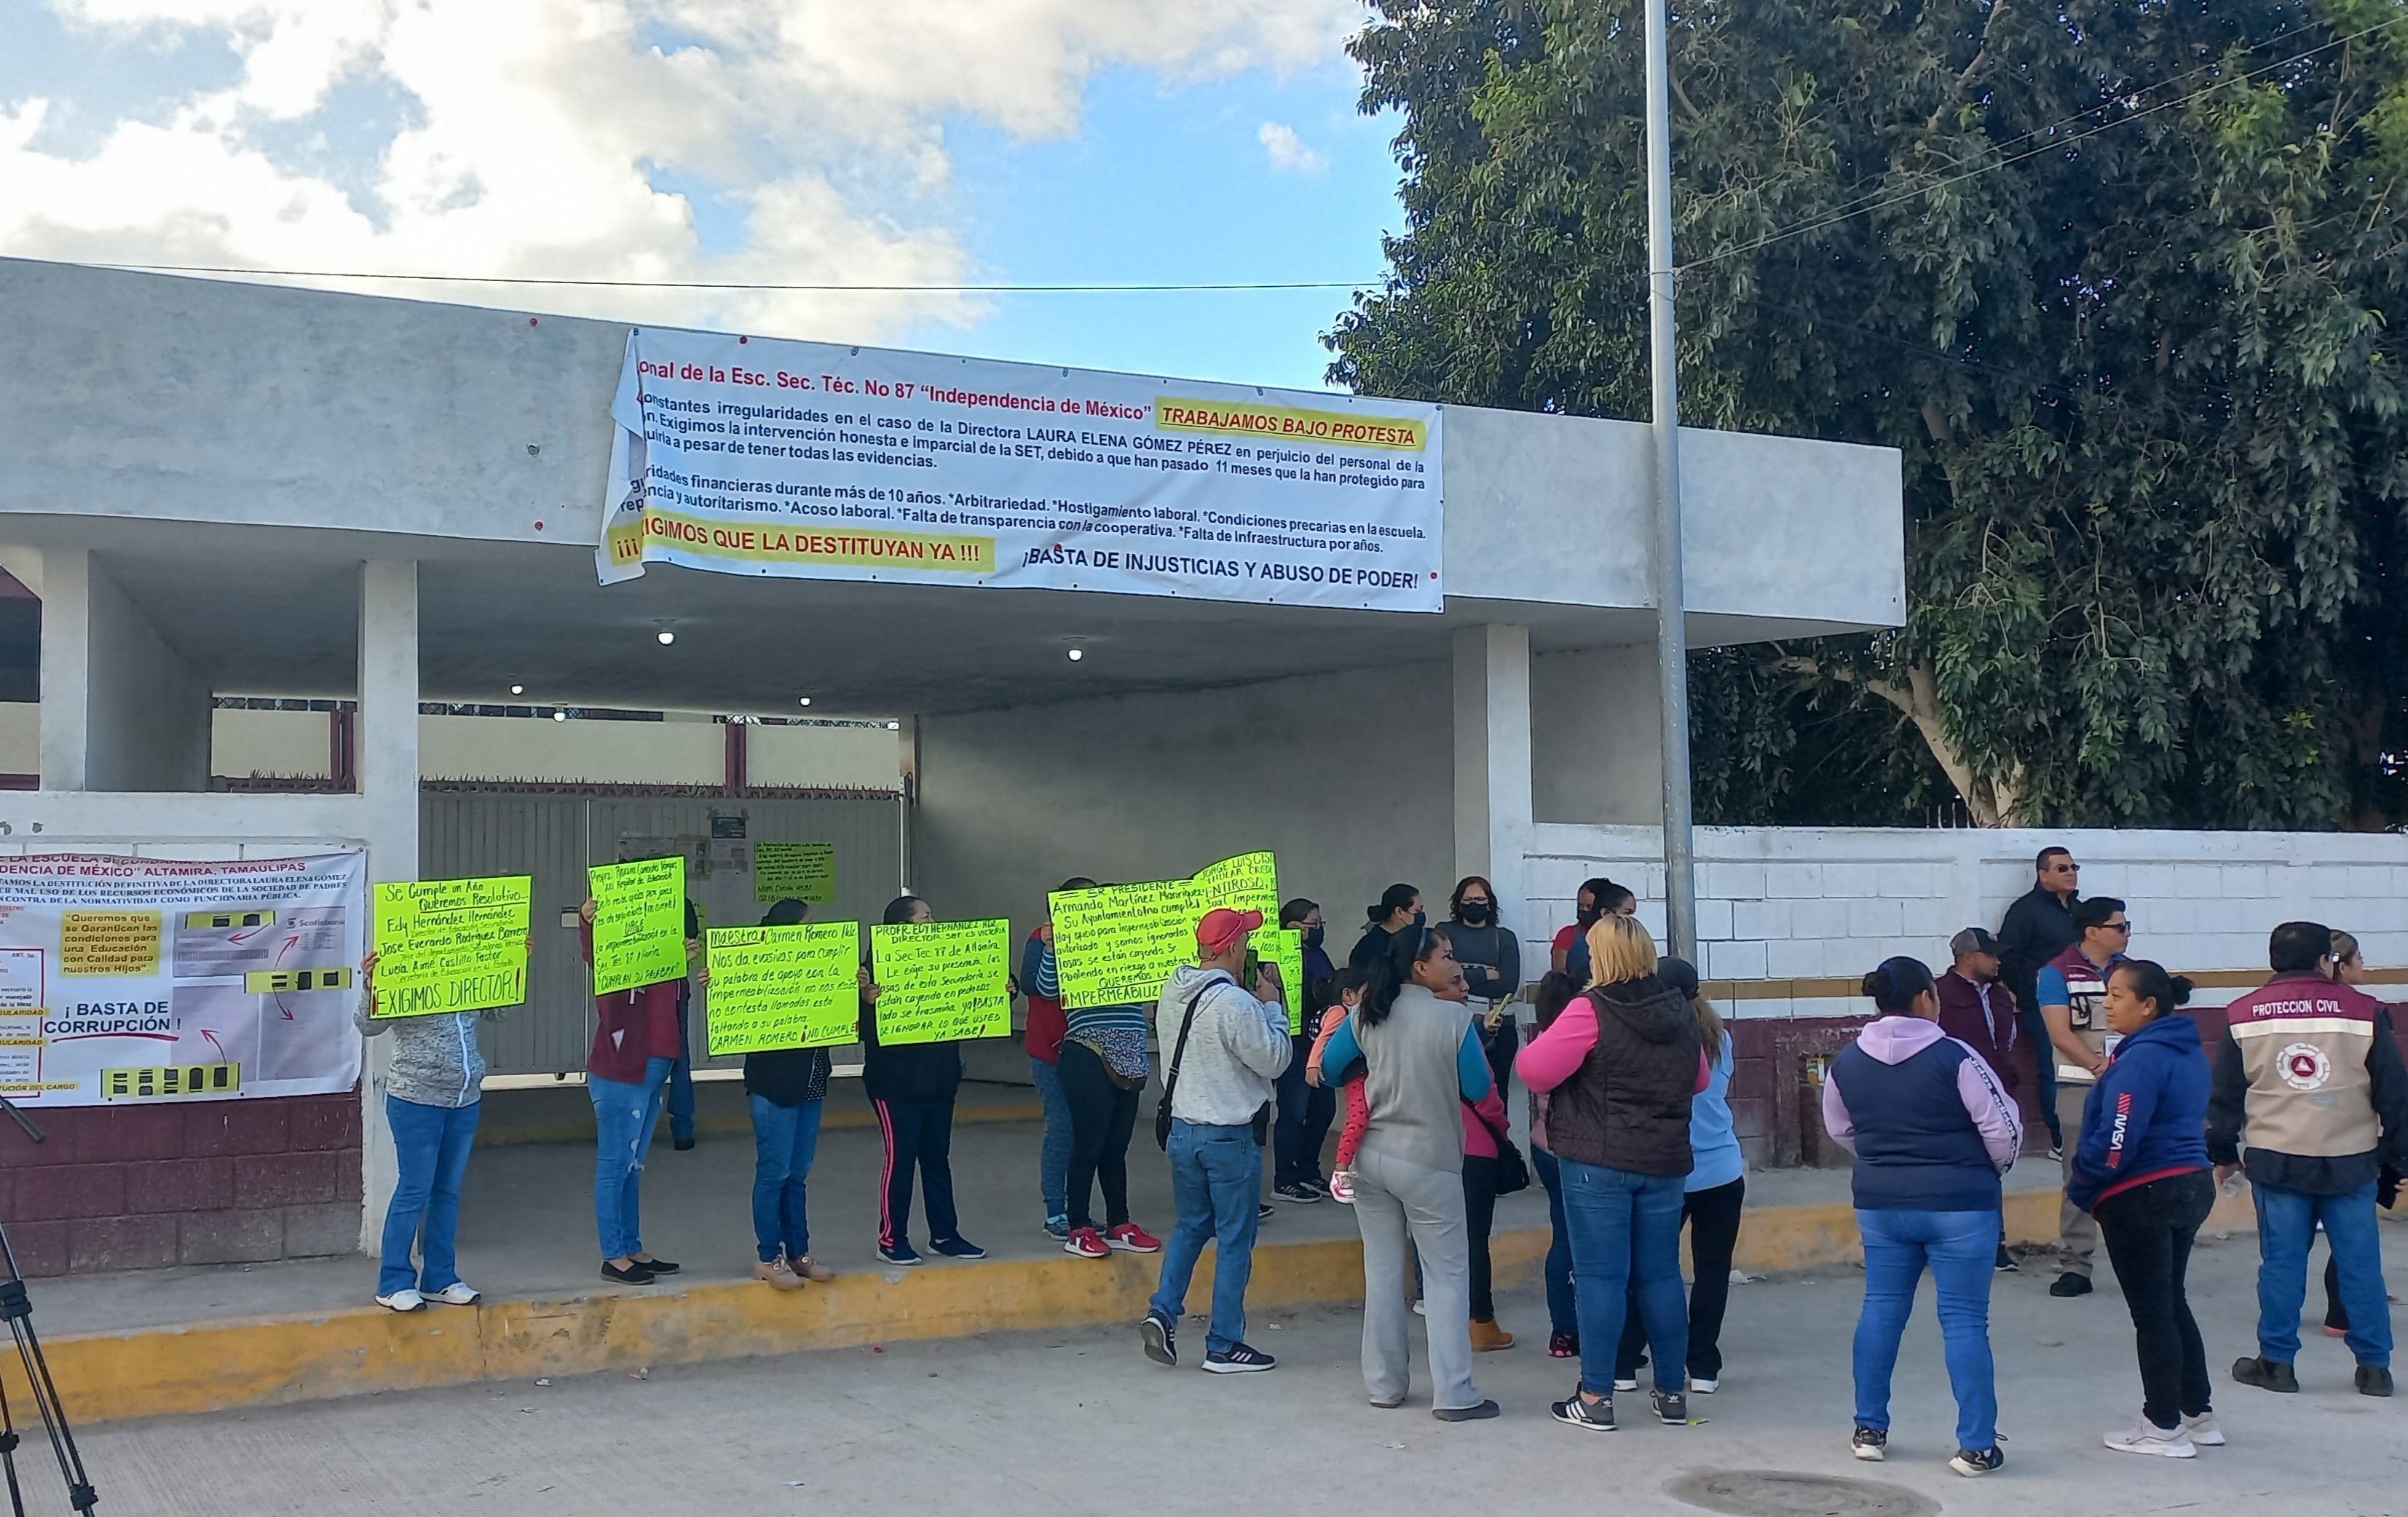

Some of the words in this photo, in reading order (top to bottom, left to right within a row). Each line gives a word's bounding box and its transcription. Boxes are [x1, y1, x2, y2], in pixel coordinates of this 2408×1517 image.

[639, 361, 674, 378] onal
[681, 364, 703, 381] de
[709, 366, 725, 382] la
[732, 367, 770, 386] Esc.
[777, 371, 815, 390] Sec.
[822, 375, 859, 393] Téc.
[865, 380, 889, 397] No
[895, 383, 915, 398] 87
[1061, 398, 1081, 413] de
[718, 401, 828, 423] irregularidades
[835, 413, 853, 424] en
[859, 413, 871, 426] el
[877, 417, 912, 429] caso
[917, 419, 934, 431] de
[941, 421, 952, 433] la
[958, 422, 1020, 439] Directora
[1027, 428, 1076, 443] LAURA
[1082, 432, 1127, 448] ELENA
[1132, 435, 1183, 452] GÓMEZ
[1188, 439, 1231, 455] PÉREZ
[1236, 447, 1250, 458] en
[1257, 450, 1310, 463] perjuicio
[1316, 453, 1334, 465] del
[1340, 456, 1390, 470] personal
[1396, 459, 1411, 470] de
[1416, 462, 1424, 472] la
[1164, 407, 1277, 431] TRABAJAMOS
[1283, 418, 1327, 436] BAJO
[1332, 423, 1415, 443] PROTESTA
[660, 413, 725, 434] Exigimos
[729, 421, 740, 435] la
[744, 423, 835, 442] intervención
[840, 430, 897, 447] honesta
[901, 437, 909, 448] e
[980, 442, 996, 455] de
[1000, 444, 1011, 456] la
[1015, 445, 1044, 461] SET,
[1048, 448, 1093, 462] debido
[1097, 453, 1104, 462] a
[1108, 455, 1131, 467] que
[1135, 455, 1158, 468] han
[1161, 459, 1209, 471] pasado
[1216, 460, 1227, 472] 11
[1231, 464, 1272, 476] meses
[1275, 468, 1297, 480] que
[1300, 468, 1310, 480] la
[1314, 470, 1336, 483] han
[1339, 474, 1398, 488] protegido
[1402, 478, 1425, 490] para
[673, 438, 680, 448] a
[684, 438, 726, 452] pesar
[728, 440, 745, 453] de
[748, 442, 786, 456] tener
[789, 445, 829, 460] todas
[833, 448, 854, 462] las
[857, 451, 937, 467] evidencias.
[691, 475, 773, 493] financieras
[775, 482, 832, 497] durante
[834, 486, 866, 499] más
[869, 488, 885, 500] de
[888, 489, 904, 502] 10
[907, 491, 946, 505] años.
[1154, 507, 1200, 522] laboral.
[1290, 520, 1346, 533] precarias
[1349, 525, 1365, 534] en
[1367, 523, 1376, 535] la
[1379, 526, 1426, 539] escuela.
[676, 492, 682, 504] y
[684, 494, 782, 512] autoritarismo.
[841, 504, 894, 520] laboral.
[940, 511, 957, 523] de
[960, 512, 1055, 529] transparencia
[1059, 520, 1081, 531] con
[1082, 520, 1092, 531] la
[1094, 523, 1176, 537] cooperativa.
[1217, 530, 1232, 542] de
[1330, 539, 1351, 551] por
[1353, 539, 1383, 552] años.
[714, 529, 754, 549] QUE
[763, 533, 790, 551] LA
[795, 535, 923, 558] DESTITUYAN
[928, 543, 956, 561] YA
[960, 544, 979, 561] !!!
[1022, 548, 1088, 567] ¡BASTA
[1093, 551, 1119, 569] DE
[1125, 553, 1239, 577] INJUSTICIAS
[1244, 561, 1257, 577] Y
[1260, 563, 1324, 582] ABUSO
[1329, 567, 1352, 584] DE
[1357, 569, 1418, 589] PODER!
[58, 866, 75, 874] DE
[221, 863, 306, 874] TAMAULIPAS
[466, 881, 483, 892] Año
[1112, 881, 1175, 895] PRESIDENTE
[130, 915, 150, 923] que
[1052, 899, 1103, 917] Armando
[765, 928, 802, 946] Carmen
[805, 924, 837, 943] Romero
[948, 945, 962, 957] de
[76, 1002, 138, 1015] BASTA
[144, 1002, 168, 1013] DE
[2253, 999, 2313, 1016] PROTECCION
[2316, 999, 2342, 1013] CIVIL
[44, 1016, 170, 1033] CORRUPCIÓN
[710, 1034, 752, 1052] CARMEN
[1993, 1093, 2016, 1137] adidas
[2109, 1114, 2127, 1150] NASA
